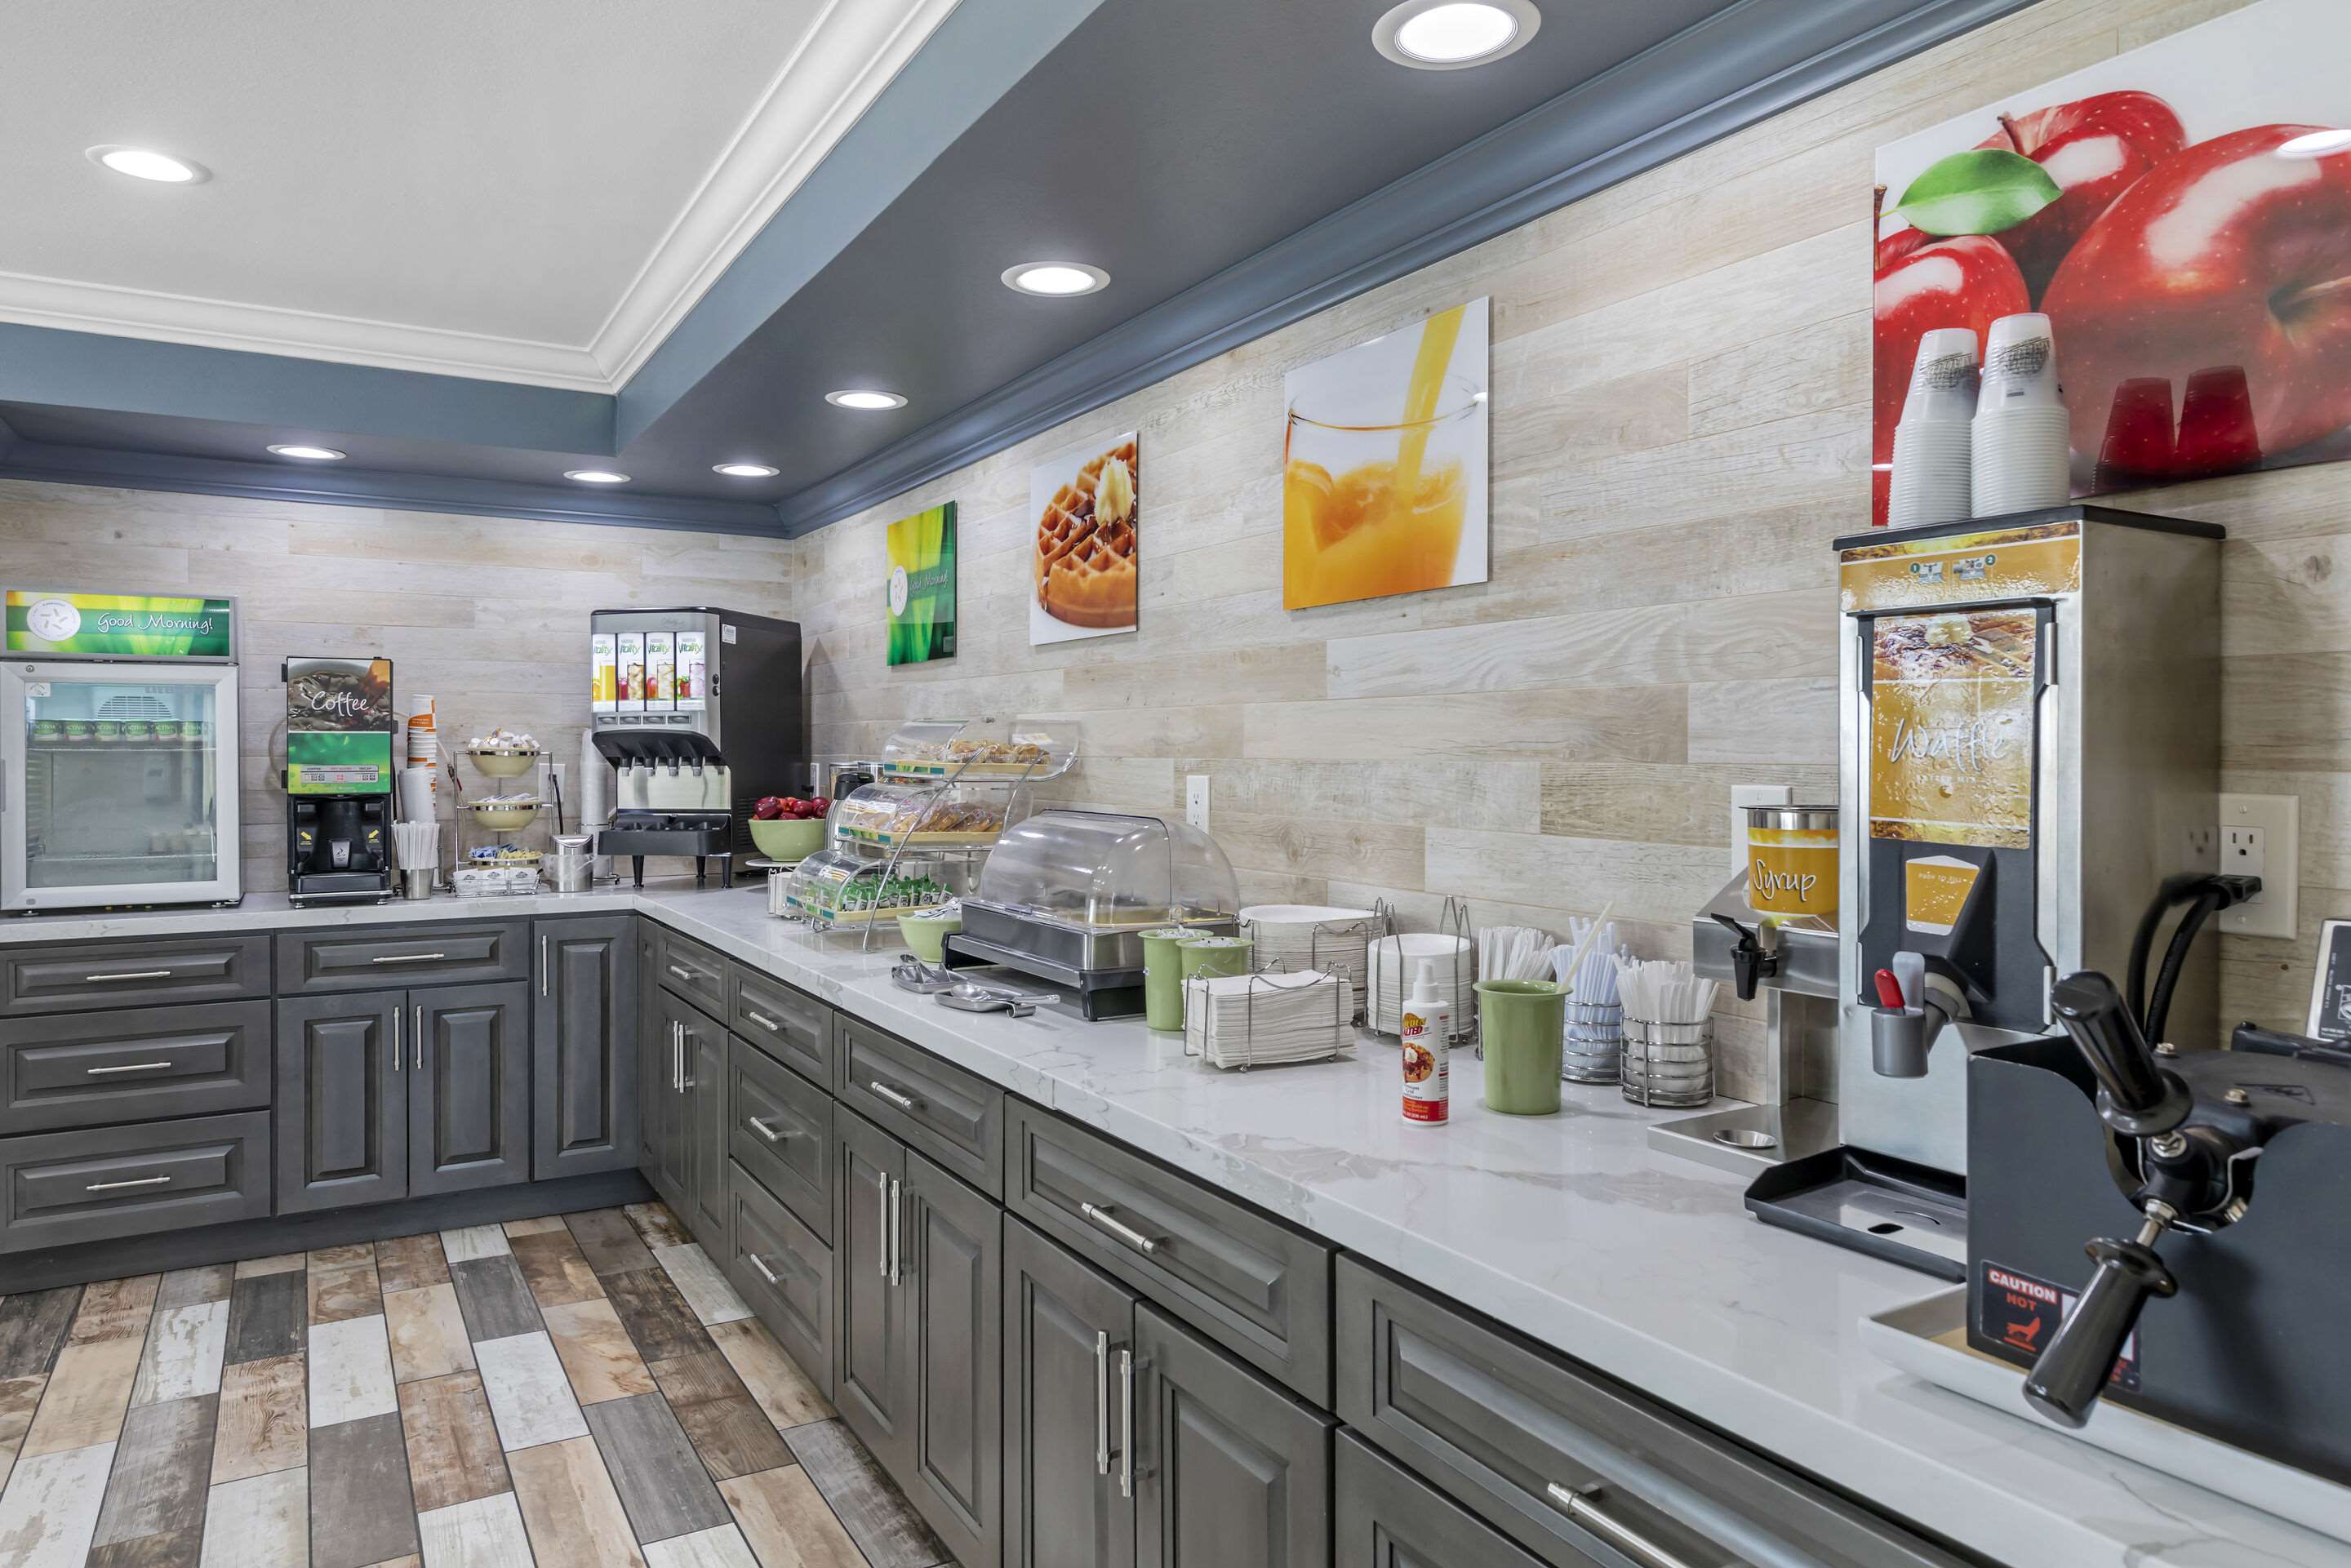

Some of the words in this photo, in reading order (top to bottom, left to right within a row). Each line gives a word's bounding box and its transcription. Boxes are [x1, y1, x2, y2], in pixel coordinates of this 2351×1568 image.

[97, 612, 133, 633] Good
[138, 615, 214, 635] Morning!
[678, 641, 703, 654] Vitality
[312, 691, 370, 717] Coffee
[1891, 717, 2008, 772] Waffle
[1753, 859, 1817, 902] Syrup
[1989, 1270, 2056, 1304] CAUTION
[2007, 1293, 2037, 1313] HOT
